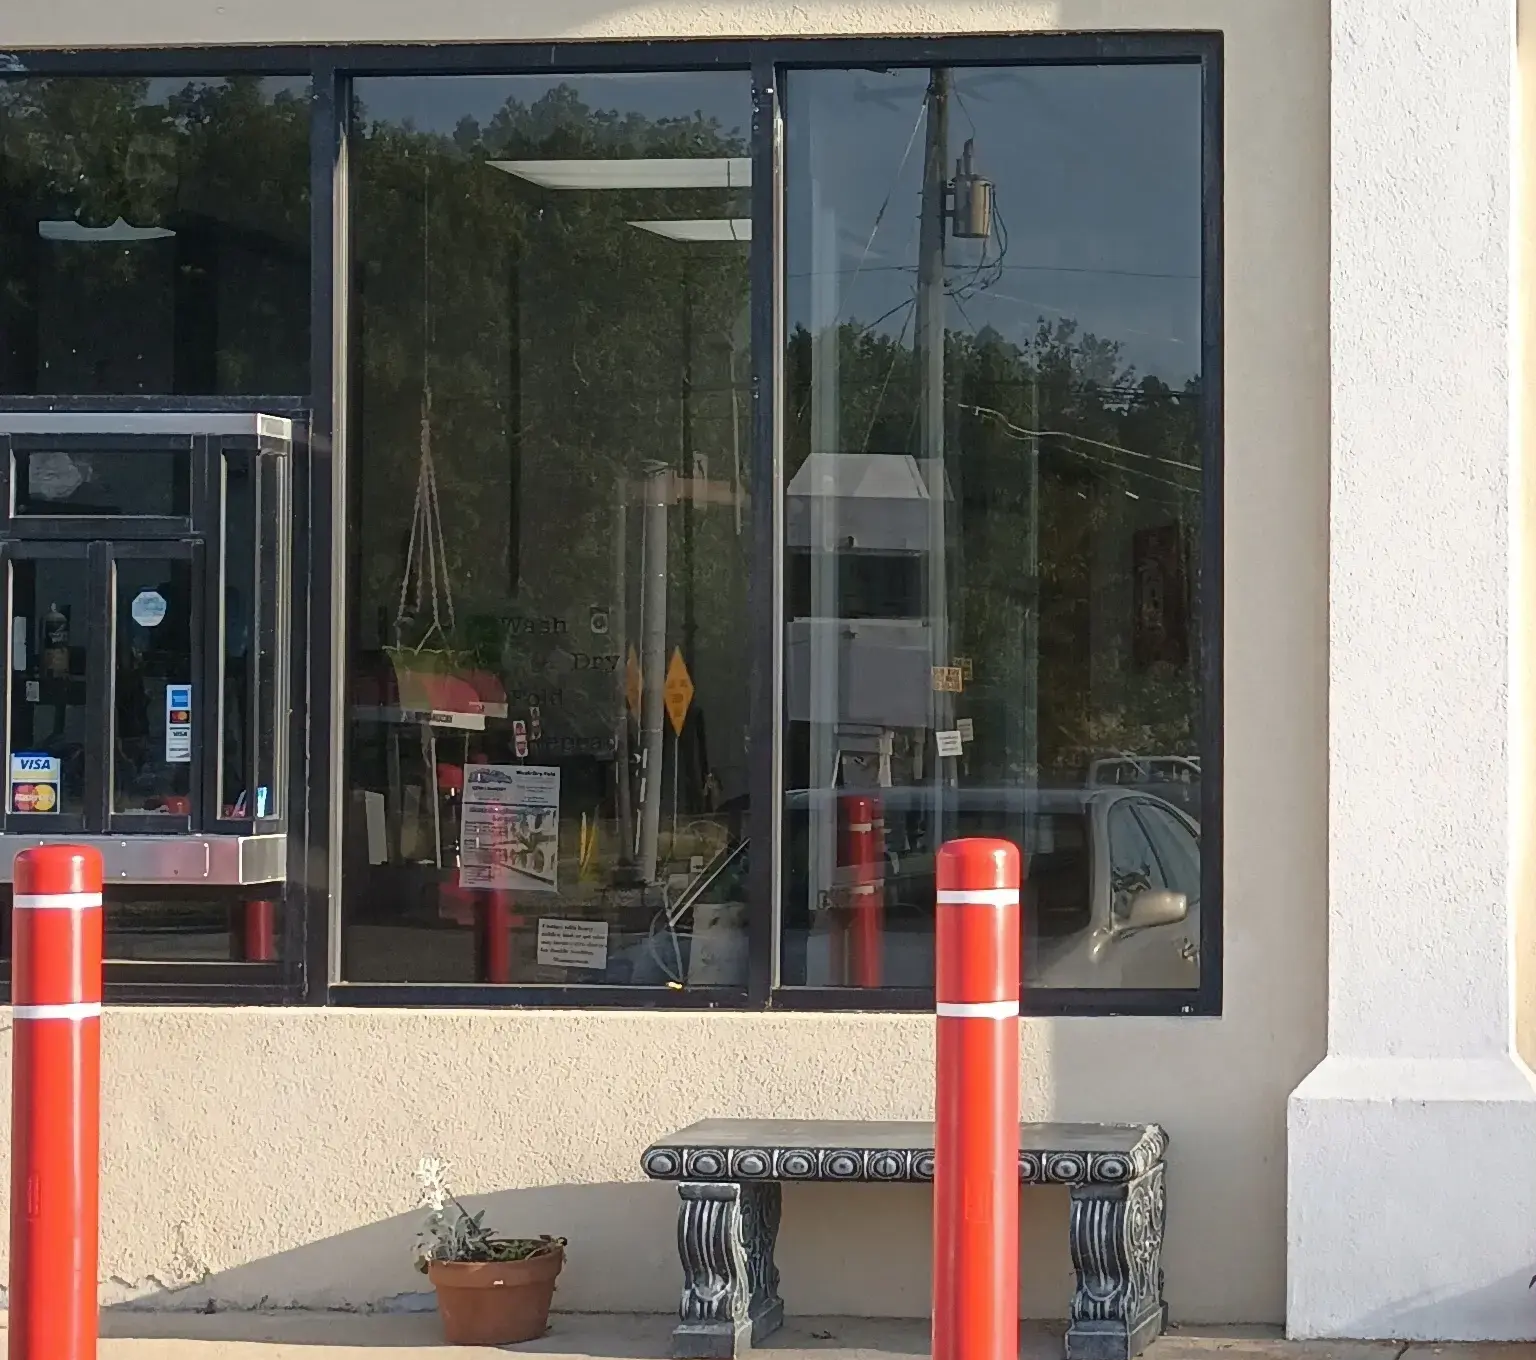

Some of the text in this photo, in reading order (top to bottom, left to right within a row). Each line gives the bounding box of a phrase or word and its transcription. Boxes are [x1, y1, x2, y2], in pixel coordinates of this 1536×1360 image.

[502, 616, 568, 635] Wash
[571, 652, 621, 673] Dry
[20, 758, 51, 770] VISA
